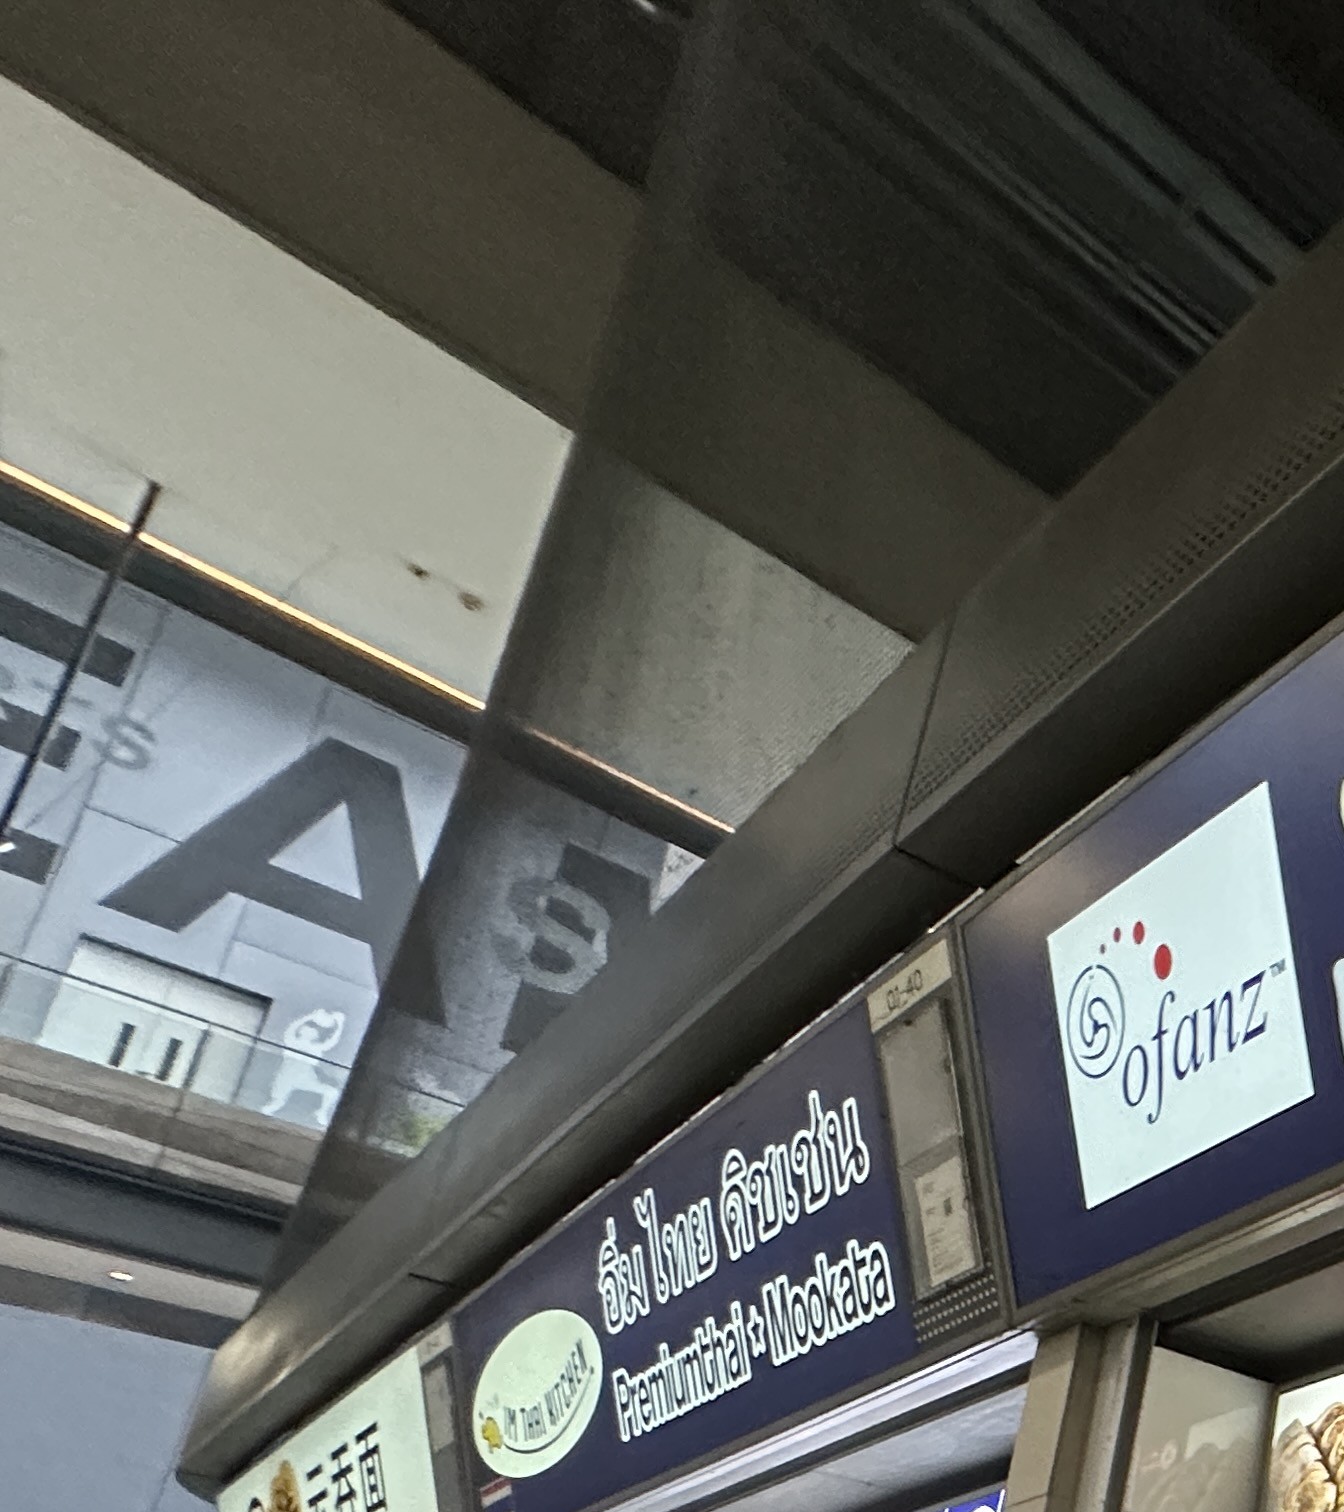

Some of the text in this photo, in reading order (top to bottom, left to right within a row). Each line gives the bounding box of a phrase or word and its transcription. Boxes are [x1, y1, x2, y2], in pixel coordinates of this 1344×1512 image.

[545, 1339, 587, 1425] KITCHEN
[612, 1240, 895, 1442] Premiumthai Mookata
